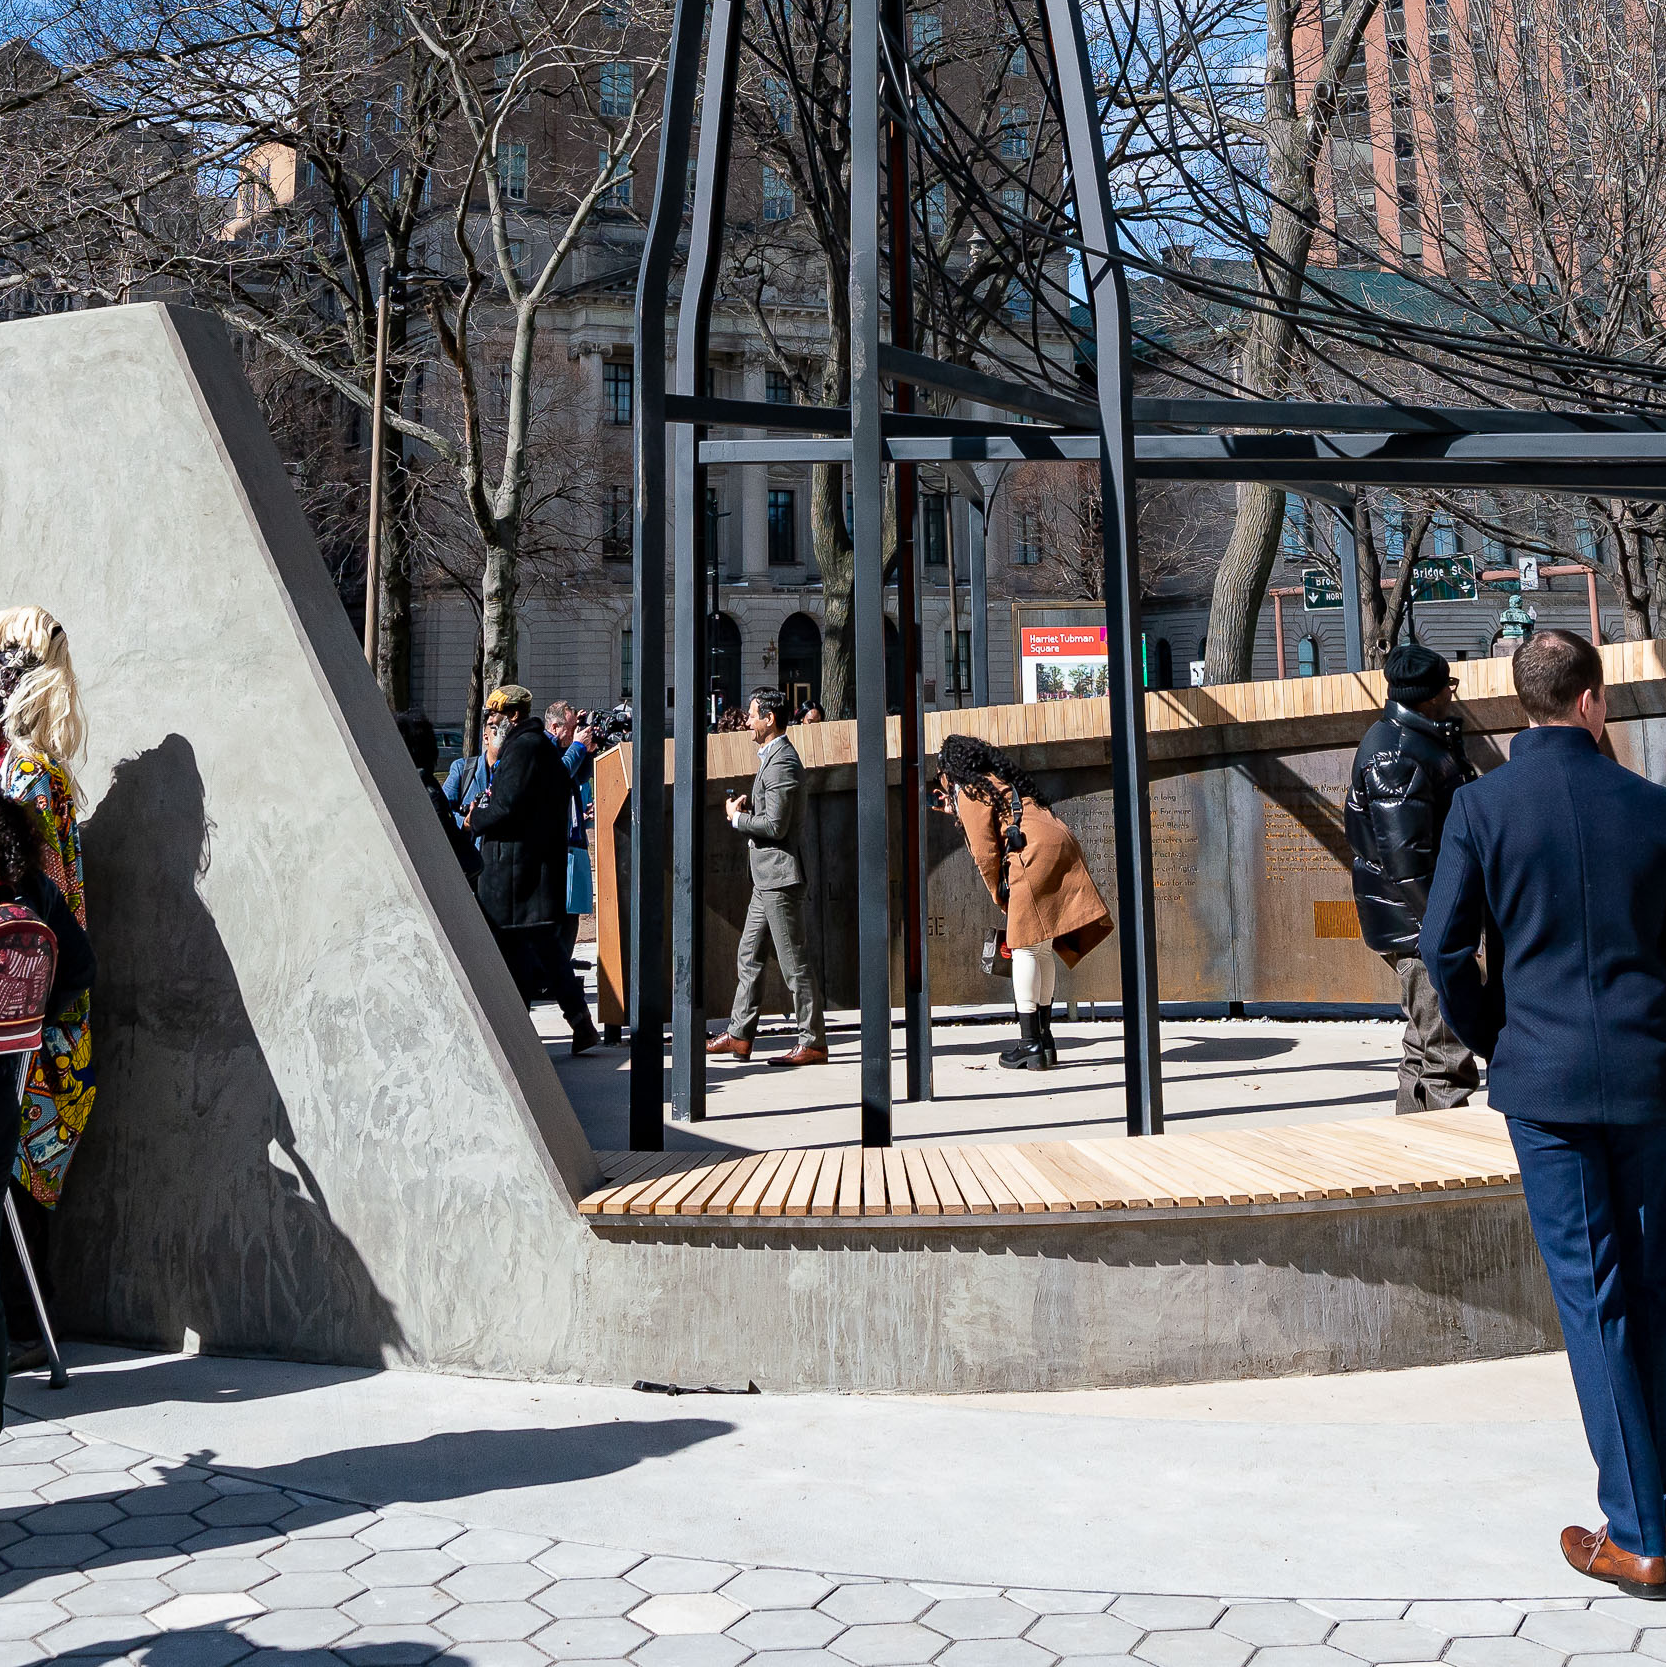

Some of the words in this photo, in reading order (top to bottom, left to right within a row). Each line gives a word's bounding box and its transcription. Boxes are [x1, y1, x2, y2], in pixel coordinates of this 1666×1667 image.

[1413, 567, 1444, 580] Bridge
[1451, 565, 1462, 576] St
[1029, 634, 1059, 644] Harriet
[1060, 634, 1095, 643] Tubman
[1030, 644, 1060, 654] Square
